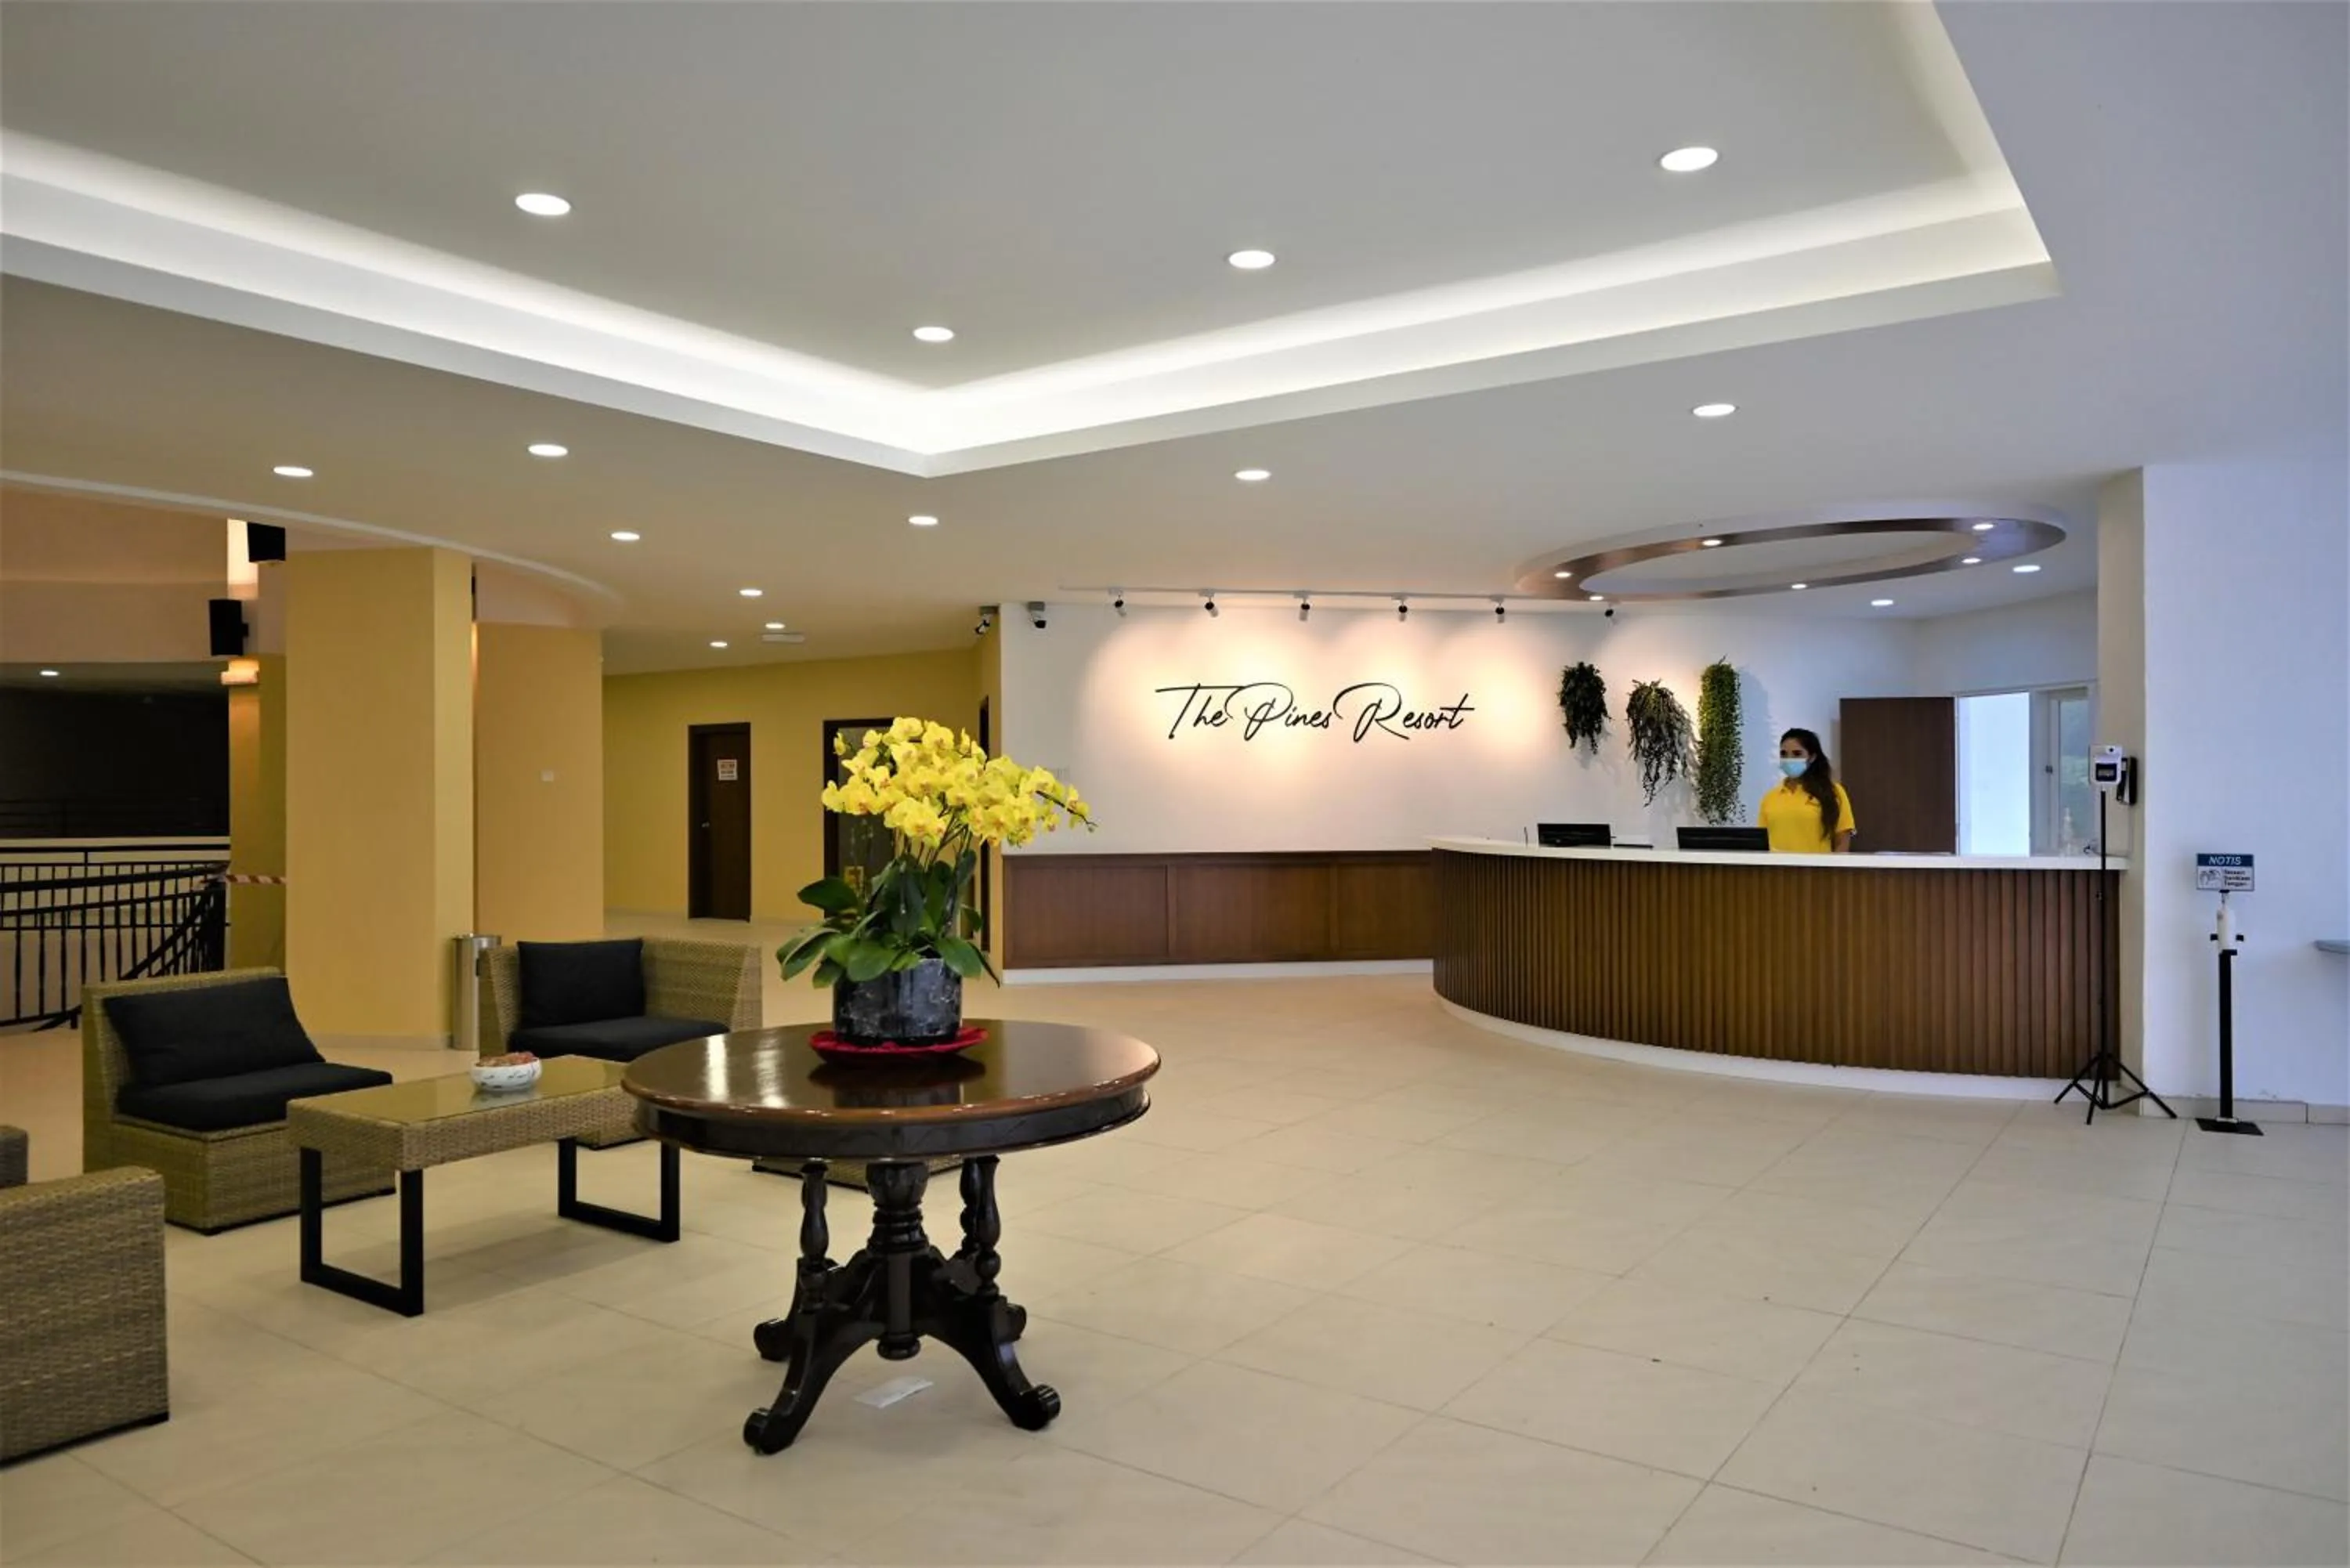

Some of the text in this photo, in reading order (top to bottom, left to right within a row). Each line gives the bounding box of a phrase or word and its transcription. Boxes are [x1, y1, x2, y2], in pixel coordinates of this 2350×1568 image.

[1155, 682, 1475, 742] The Pines Resort
[2208, 856, 2241, 865] NOTIS
